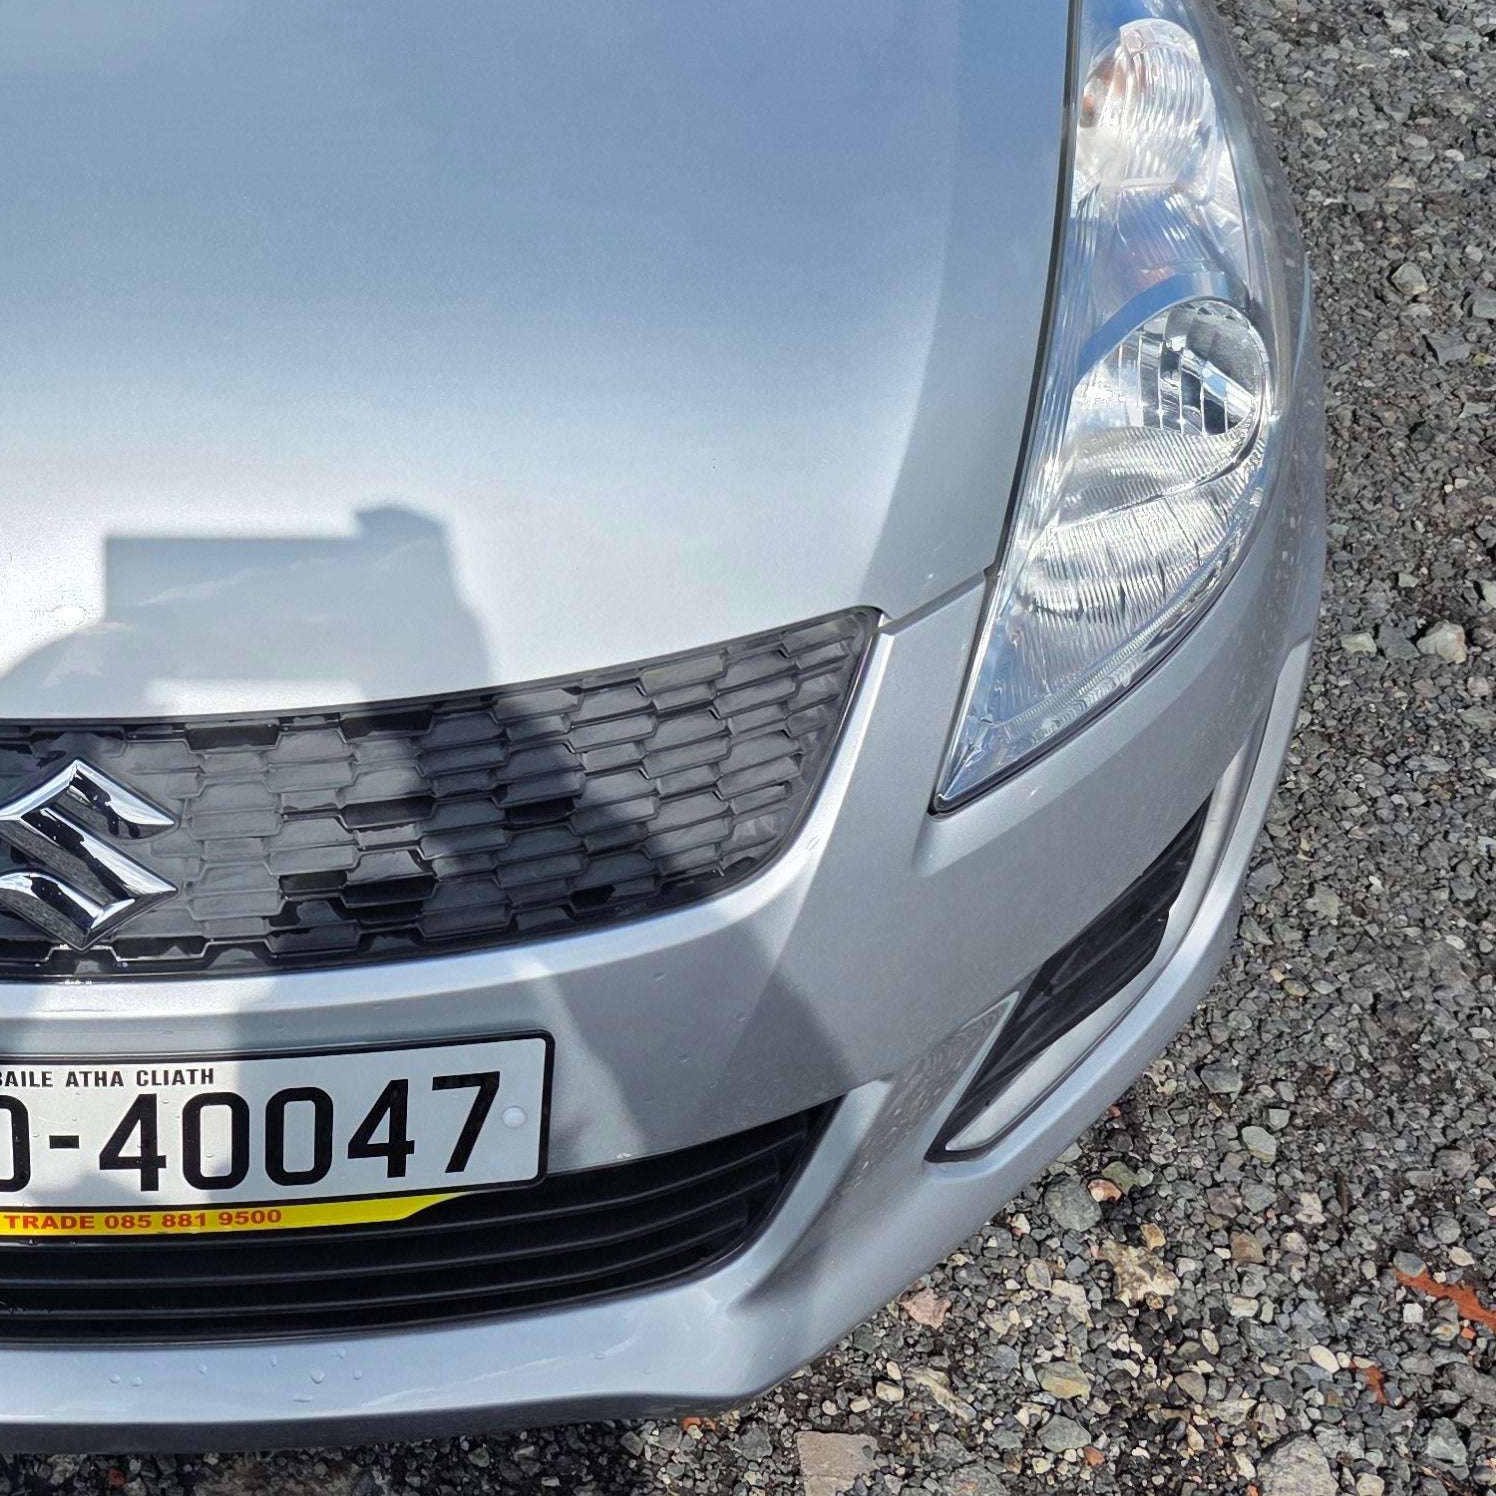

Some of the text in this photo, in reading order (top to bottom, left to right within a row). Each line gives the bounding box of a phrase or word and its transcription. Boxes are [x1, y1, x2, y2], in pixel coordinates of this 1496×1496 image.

[65, 1069, 124, 1087] ATHA
[136, 1067, 215, 1087] CLIATH
[5, 1213, 95, 1230] TRADE
[104, 1212, 153, 1229] 085
[161, 1211, 206, 1228] 881
[217, 1208, 282, 1226] 9500
